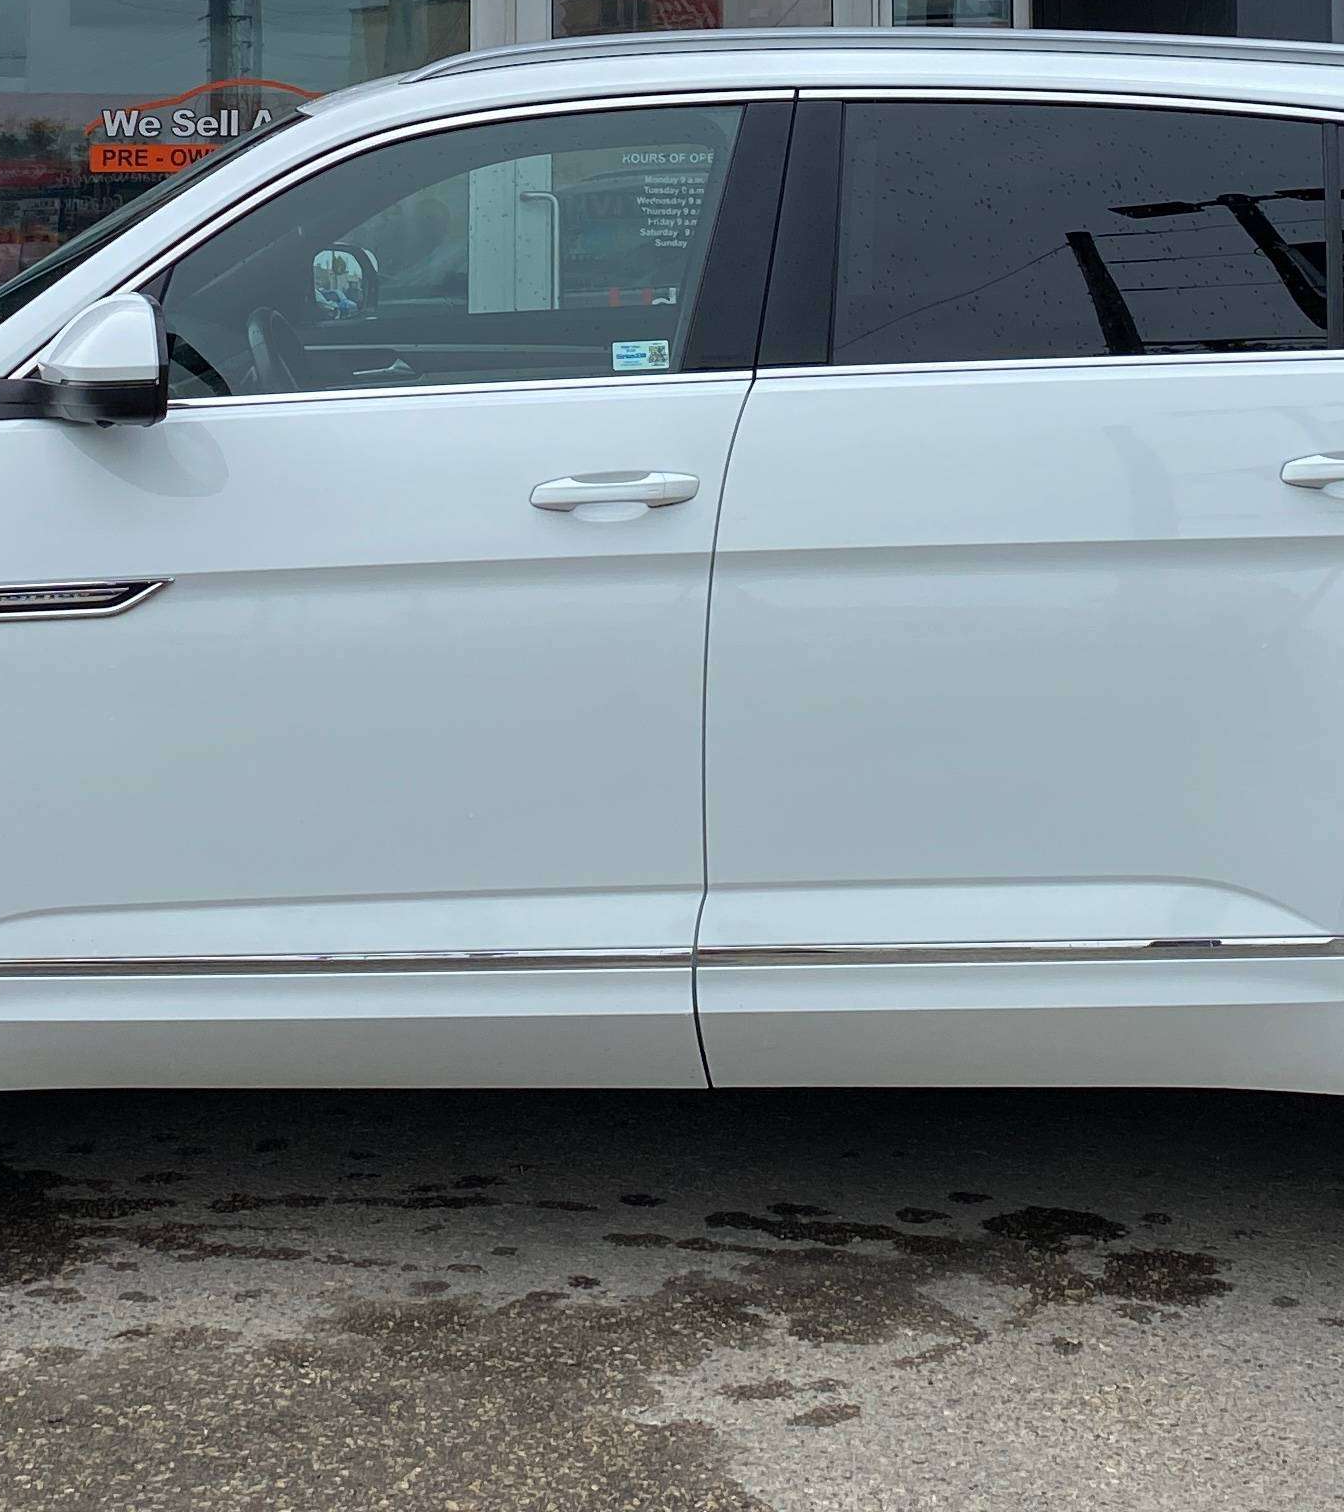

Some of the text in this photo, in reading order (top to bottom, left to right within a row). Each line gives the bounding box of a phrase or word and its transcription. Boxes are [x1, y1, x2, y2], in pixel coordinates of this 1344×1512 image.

[101, 109, 161, 138] We
[171, 109, 239, 138] Sell
[102, 149, 148, 167] PRE
[171, 148, 216, 167] OW
[622, 153, 666, 164] HOURS
[669, 153, 686, 163] OF
[644, 186, 679, 196] Tuesday
[639, 228, 679, 238] Saturday
[654, 239, 688, 249] Sunday
